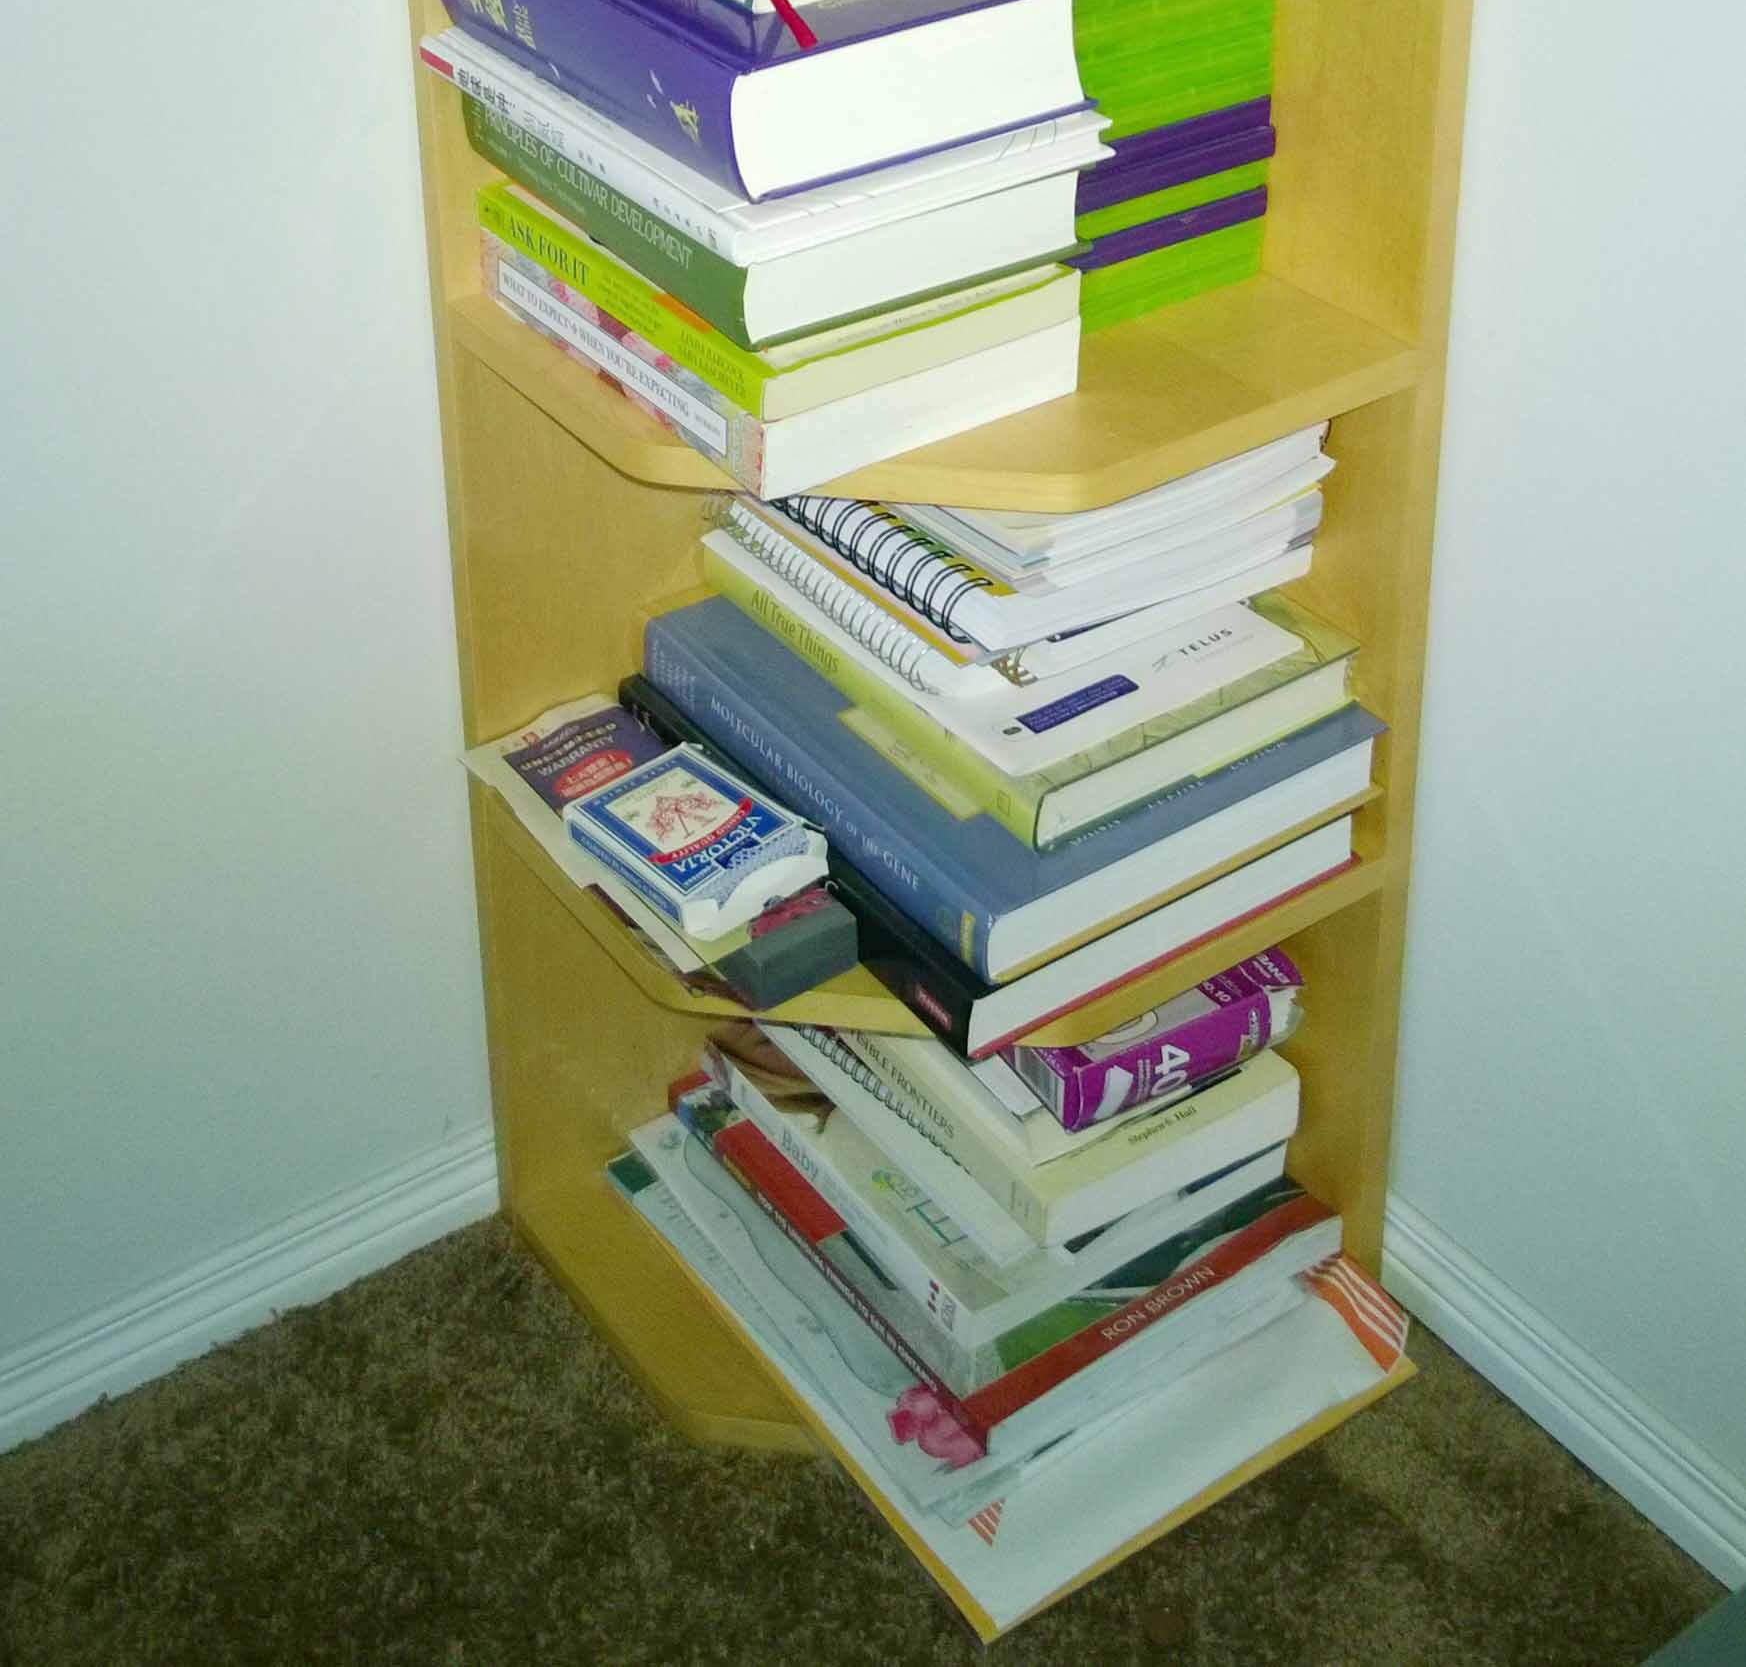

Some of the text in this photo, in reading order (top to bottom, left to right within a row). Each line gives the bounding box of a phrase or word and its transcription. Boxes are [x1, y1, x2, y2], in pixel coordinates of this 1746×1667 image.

[485, 105, 538, 158] PRINCIPLES
[540, 145, 554, 169] OF
[557, 157, 608, 211] CULTIVAR
[610, 195, 693, 270] DEVELOPMENT
[508, 214, 588, 286] ASK FOR IT
[751, 589, 840, 674] All True Things
[1178, 628, 1232, 656] TELUS
[537, 734, 615, 777] WARRANTY
[710, 693, 783, 770] MOLECULAR
[786, 762, 842, 822] BIOLOGY
[882, 850, 920, 892] GENE
[672, 816, 762, 872] VICTORIA
[1150, 1043, 1192, 1097] 40
[889, 1066, 955, 1139] FRONTIERS
[1175, 1105, 1198, 1129] Hall
[780, 1128, 820, 1180] Baby
[1101, 1264, 1215, 1340] RON BROWN
